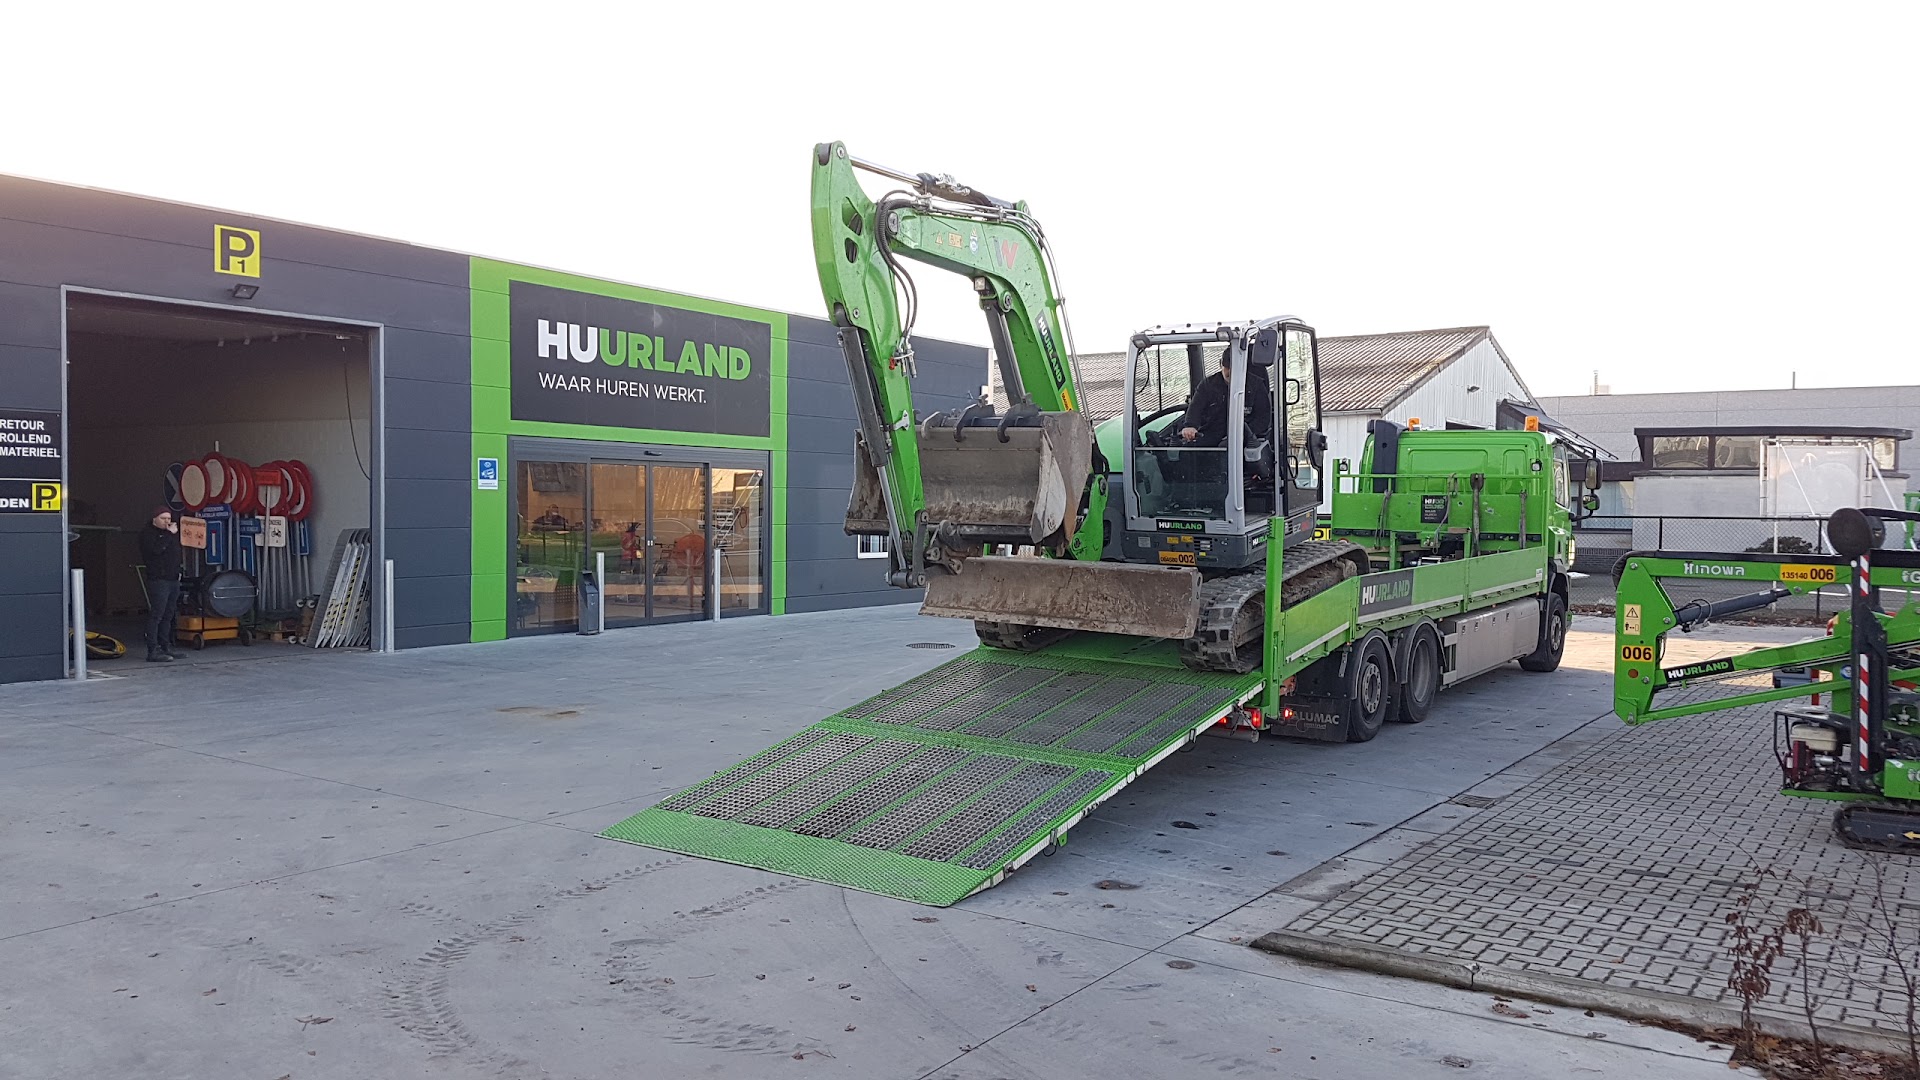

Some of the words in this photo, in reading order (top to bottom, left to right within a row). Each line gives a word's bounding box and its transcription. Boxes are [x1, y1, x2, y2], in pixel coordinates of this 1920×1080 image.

[537, 318, 751, 381] HUURLAND
[1038, 316, 1062, 383] HUURLAND
[538, 372, 591, 393] WAAR
[596, 378, 649, 398] HUREN
[654, 384, 707, 404] WERKT.
[0, 419, 45, 431] RETOUR
[0, 433, 51, 445] ROLLEND
[0, 447, 60, 458] MATERIEEL
[1158, 521, 1203, 530] HUURLAND
[1178, 554, 1195, 564] 002
[1781, 571, 1808, 580] 135140
[1810, 568, 1834, 580] 006
[1362, 579, 1410, 606] HUURLAND
[1622, 646, 1652, 661] 006
[1667, 661, 1729, 679] HUURLAND
